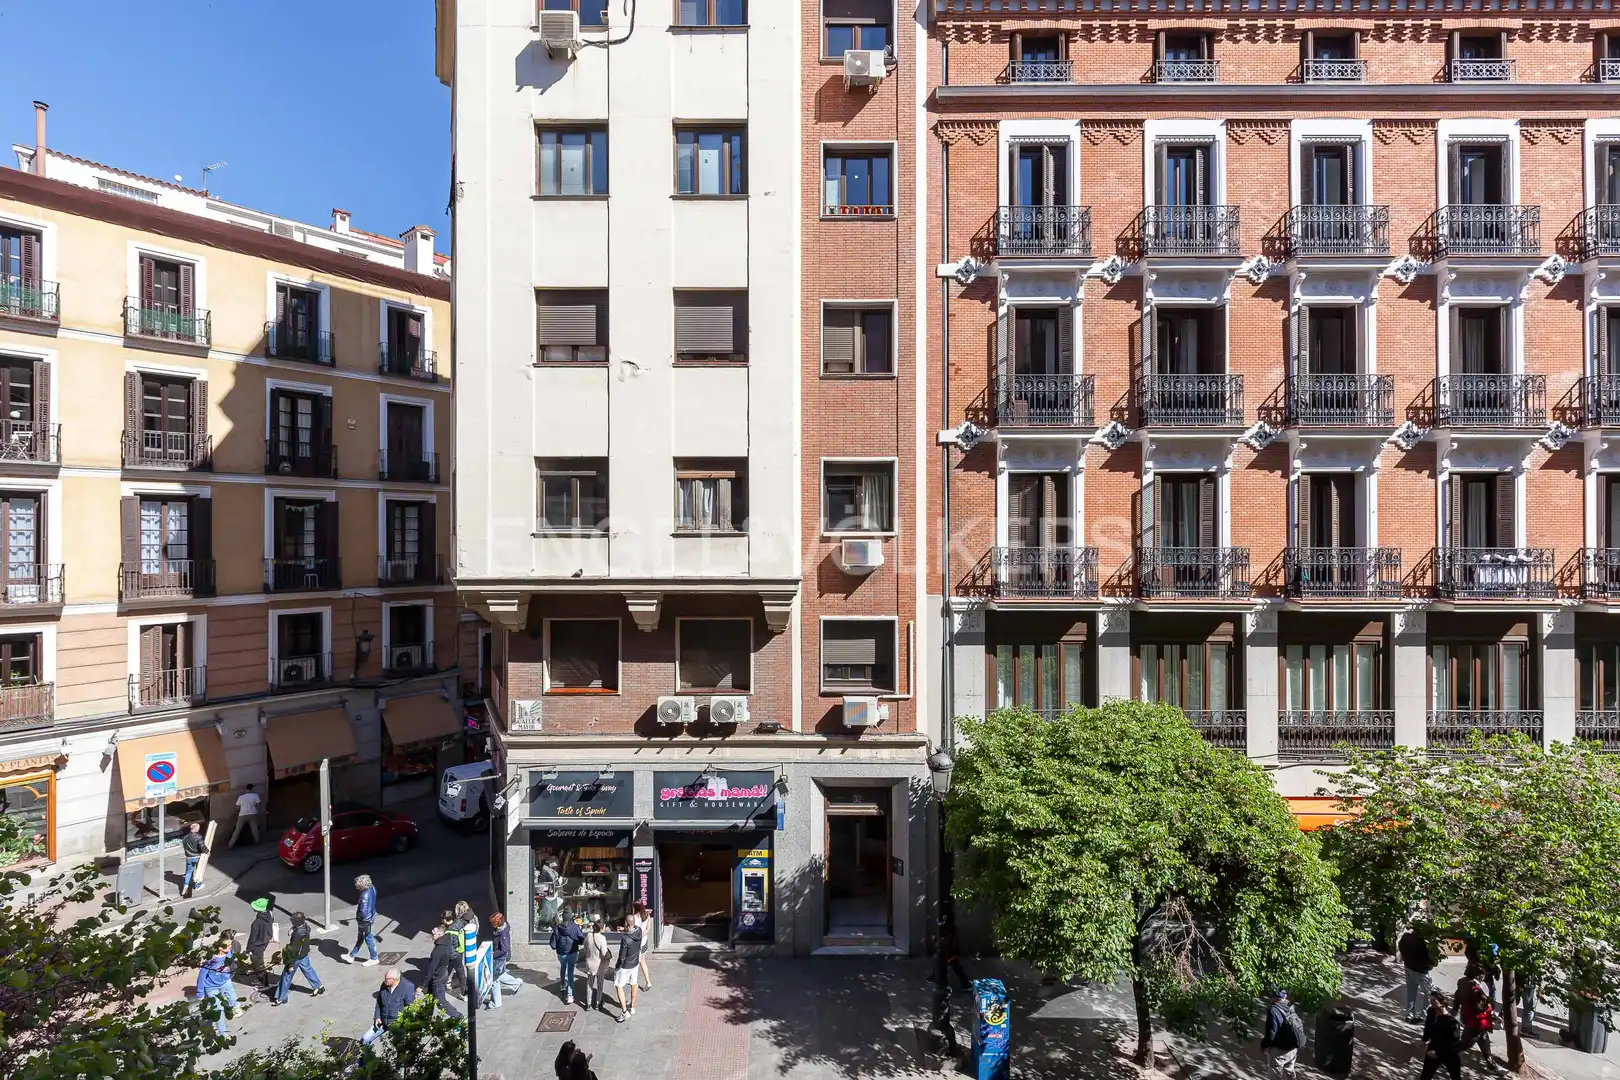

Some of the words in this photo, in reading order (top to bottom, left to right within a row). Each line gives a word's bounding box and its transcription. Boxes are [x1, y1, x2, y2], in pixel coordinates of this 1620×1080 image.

[10, 754, 57, 769] PLANTAS
[660, 785, 716, 800] gracias
[557, 805, 575, 815] Taste
[575, 806, 584, 816] of
[584, 806, 606, 817] Spain
